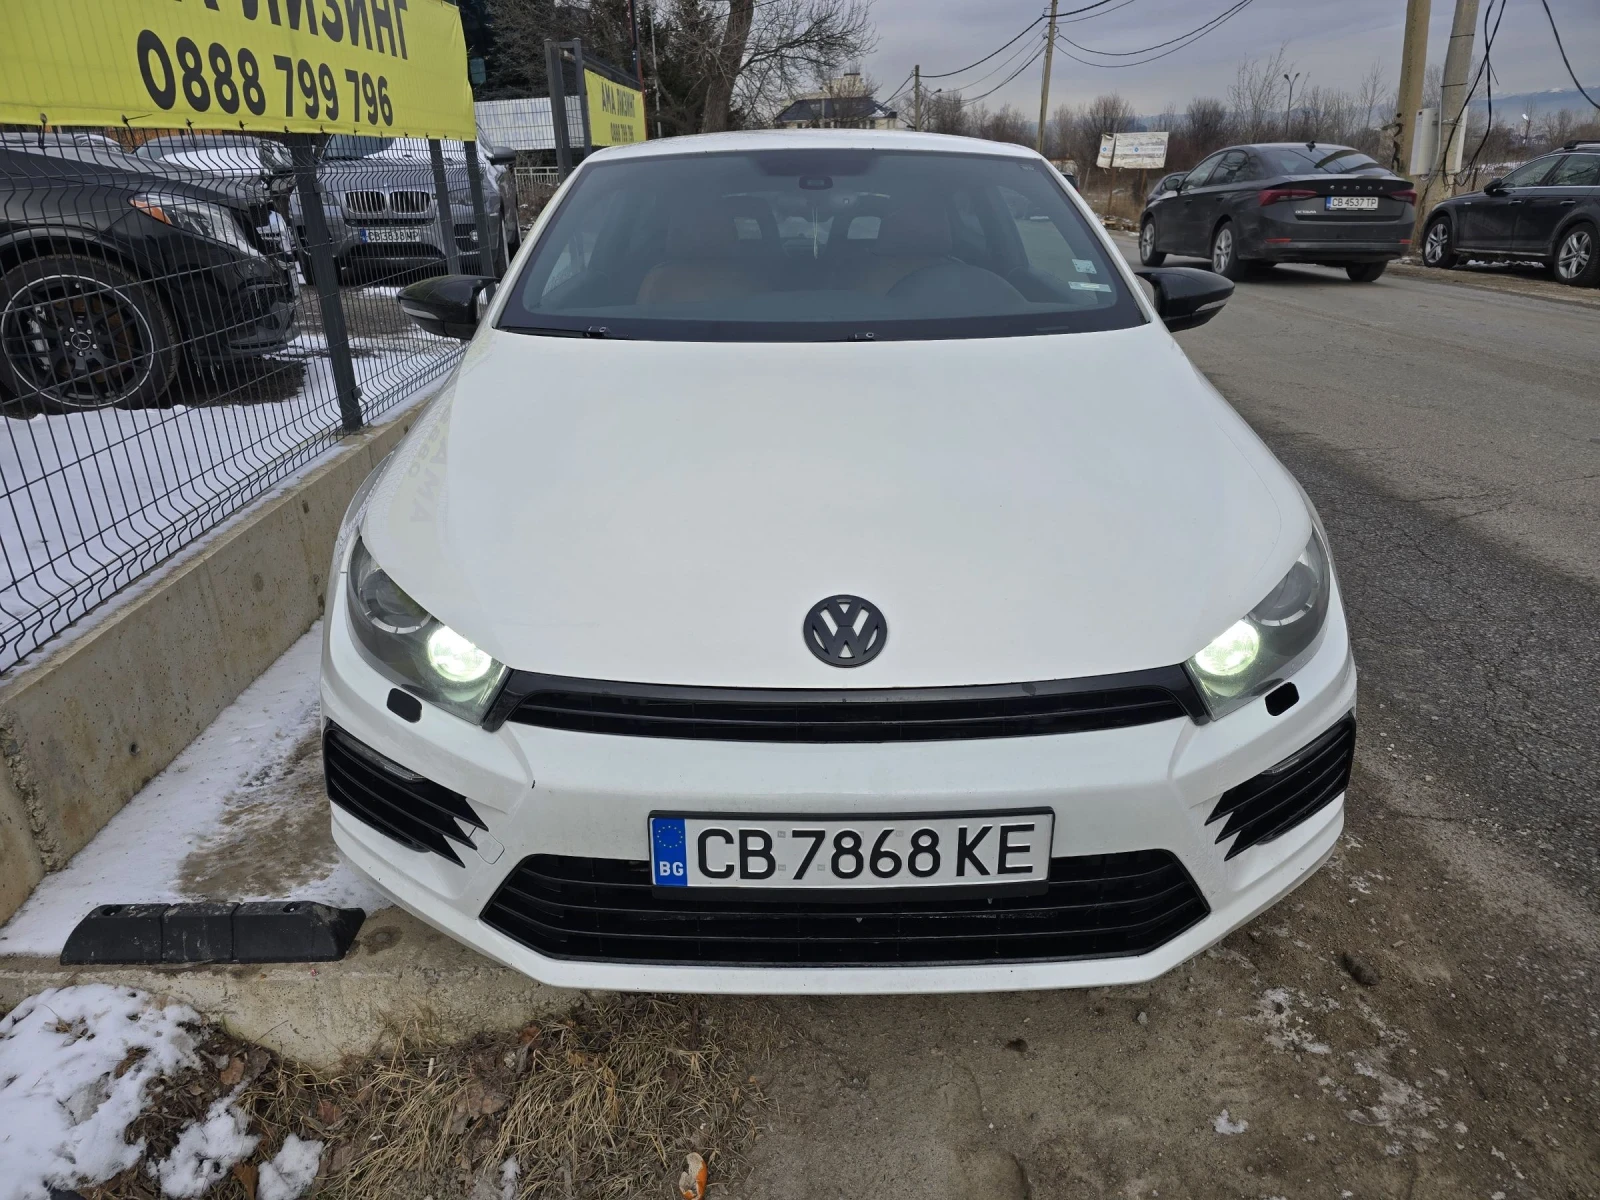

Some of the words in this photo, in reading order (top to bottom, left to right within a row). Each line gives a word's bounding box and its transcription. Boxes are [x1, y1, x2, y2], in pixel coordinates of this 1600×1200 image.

[241, 0, 408, 60] ЗИНГ
[137, 29, 266, 116] 0888
[273, 54, 339, 121] 799
[344, 68, 394, 127] 796
[1332, 198, 1343, 207] CB
[1344, 198, 1364, 207] 4537
[1366, 198, 1377, 207] TP
[659, 861, 684, 876] BG
[697, 828, 776, 880] CB
[791, 828, 941, 880] 7868
[956, 823, 1035, 877] KE
